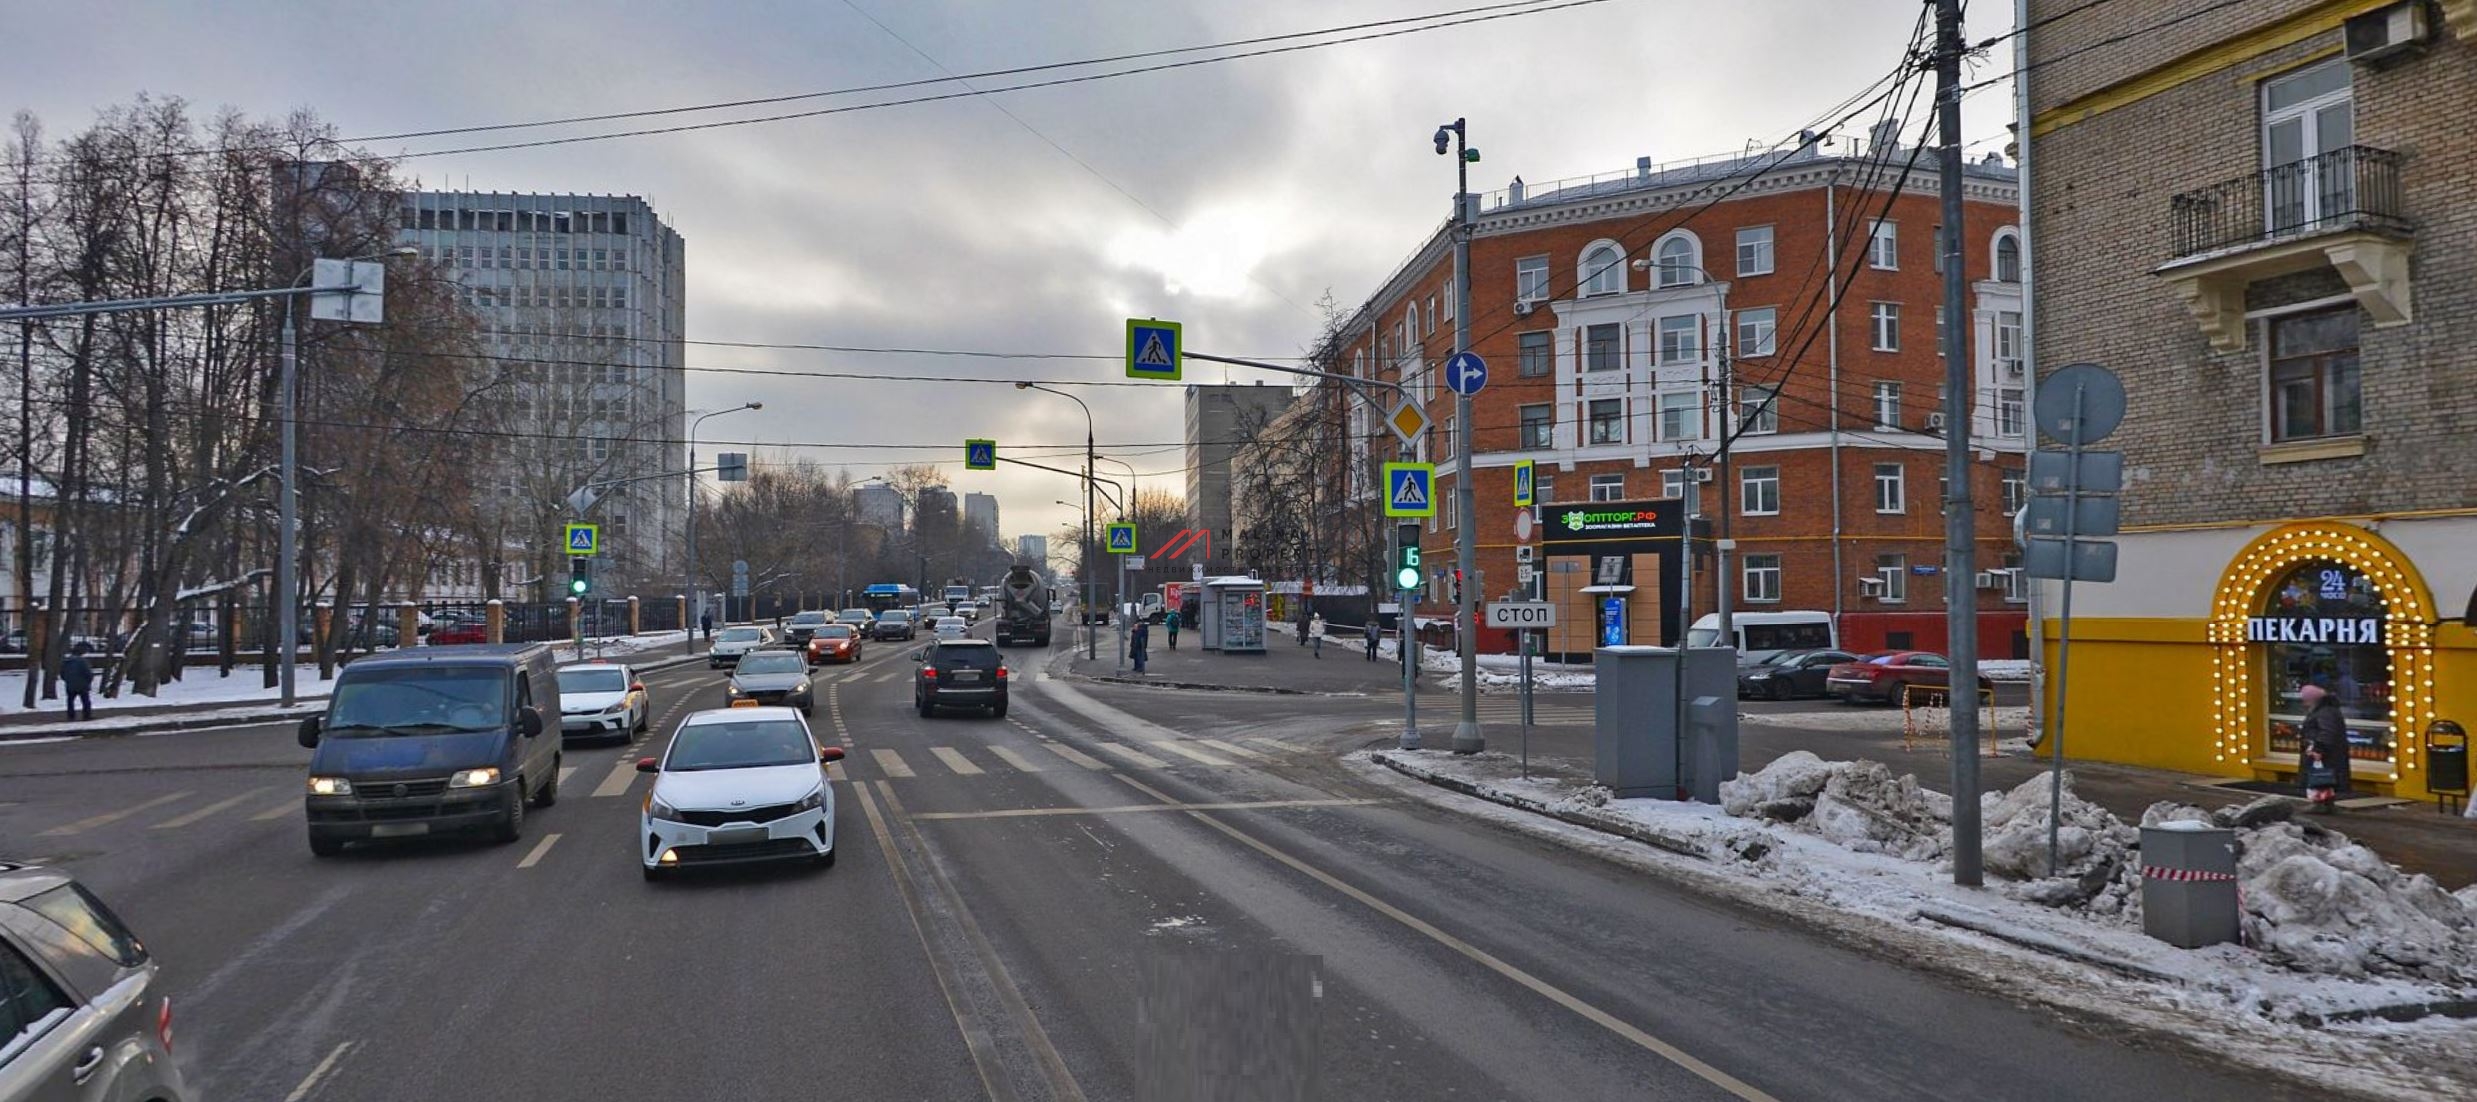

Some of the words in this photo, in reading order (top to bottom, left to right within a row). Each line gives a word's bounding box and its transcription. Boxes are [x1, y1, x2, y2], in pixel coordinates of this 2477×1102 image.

[1561, 511, 1657, 527] ЗОПТТОРГ.РФ
[1407, 547, 1419, 566] 16
[2320, 570, 2346, 590] 24
[1497, 608, 1547, 622] СТОП
[2248, 618, 2378, 643] ПЕКАРНЯ
